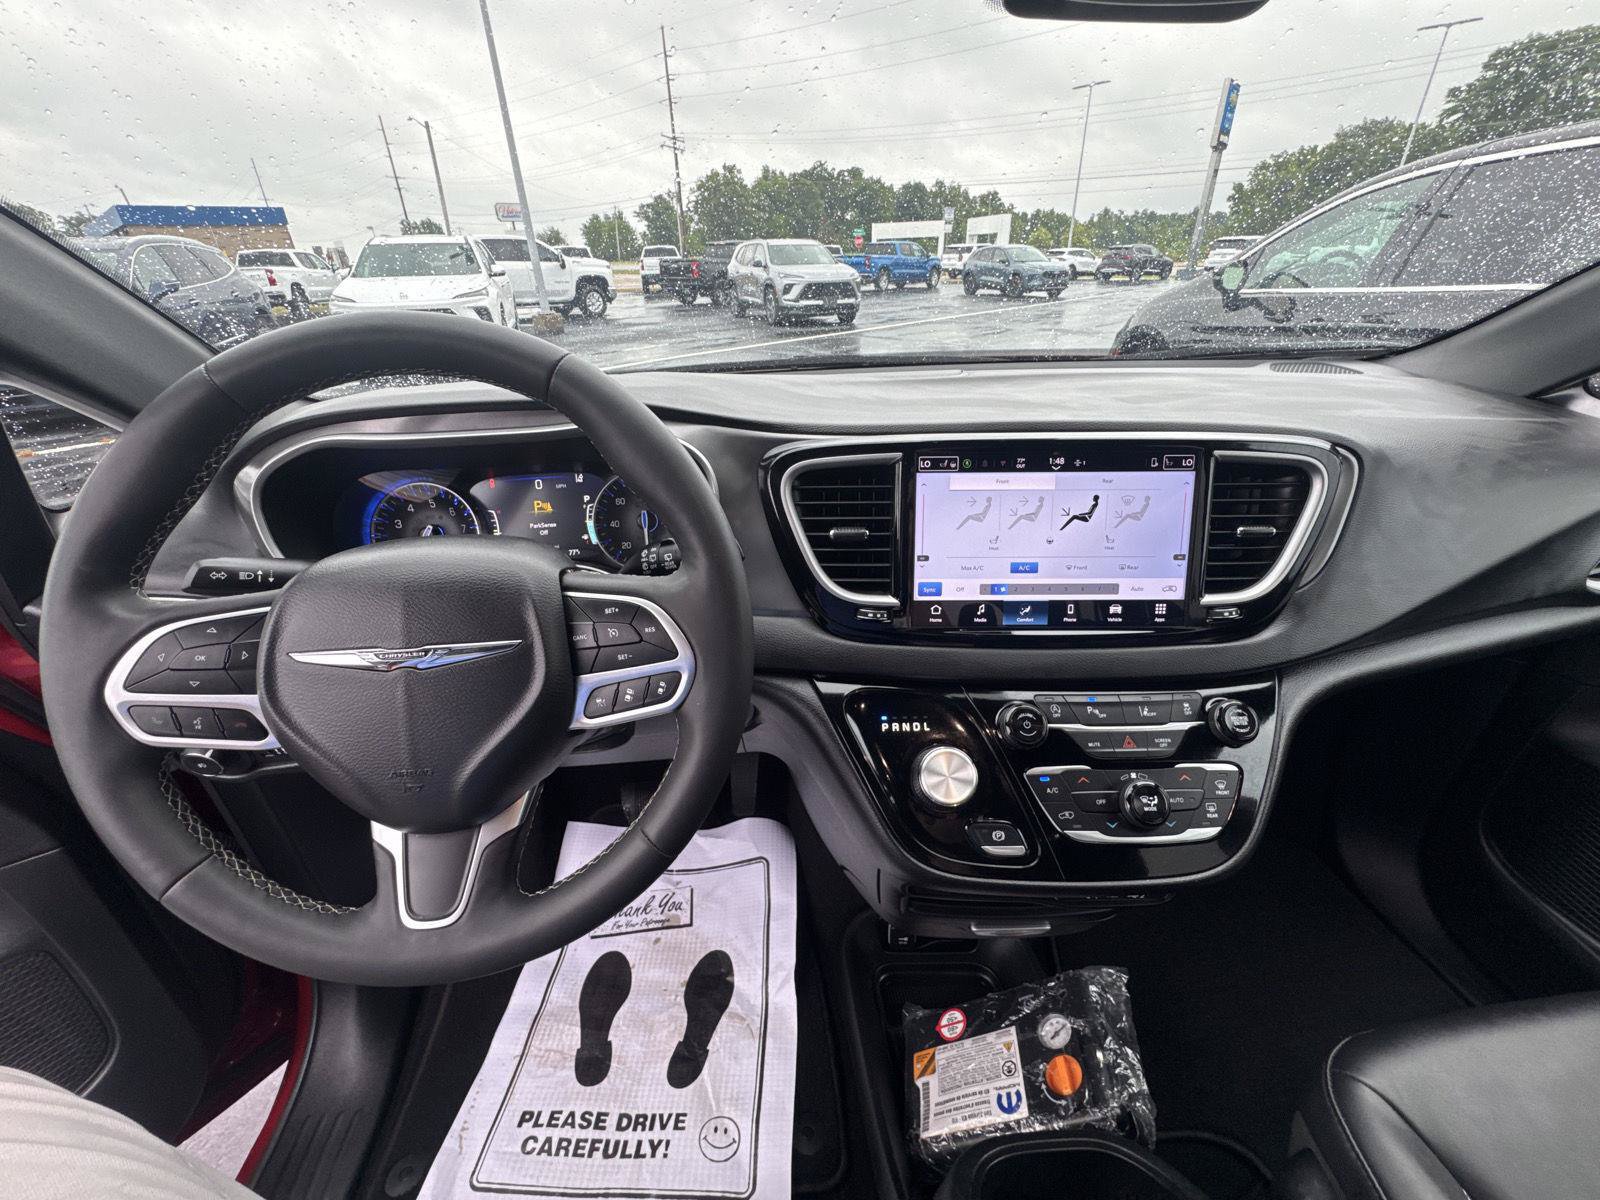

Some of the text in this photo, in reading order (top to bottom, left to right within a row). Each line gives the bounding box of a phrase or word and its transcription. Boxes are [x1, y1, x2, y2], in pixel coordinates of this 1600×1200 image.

[920, 460, 931, 468] LO
[1049, 457, 1065, 465] 1:48
[407, 504, 415, 512] 4
[394, 520, 402, 529] 3
[610, 520, 620, 528] 40
[461, 524, 466, 533] 7
[621, 541, 632, 549] 20
[923, 586, 936, 594] Sync
[379, 651, 425, 659] CHRYSLER
[613, 892, 683, 918] ank You
[517, 1110, 688, 1132] PLEASE DRIVE
[520, 1136, 671, 1160] CAREFULLY!
